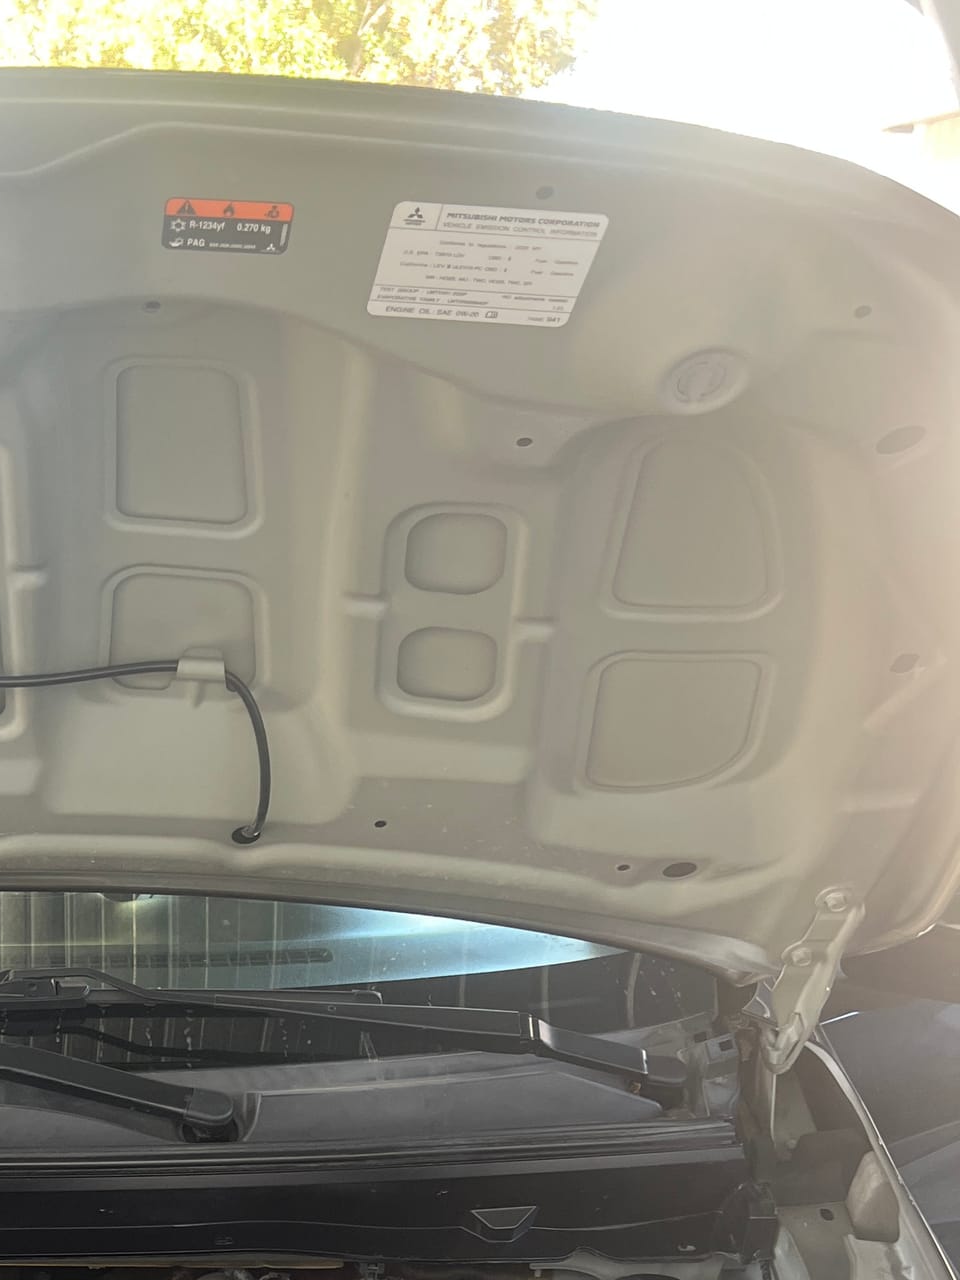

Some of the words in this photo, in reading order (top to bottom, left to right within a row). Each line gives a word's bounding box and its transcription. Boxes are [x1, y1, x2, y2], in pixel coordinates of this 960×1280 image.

[189, 220, 225, 232] R-1234yf
[237, 223, 258, 232] 0.270
[260, 224, 271, 234] kg
[446, 211, 498, 223] MITSUBISHI
[499, 215, 536, 225] MOTORS
[538, 217, 601, 228] CORPORATION
[443, 222, 472, 230] VEHICLE
[476, 224, 510, 233] EMISSION
[513, 226, 546, 235] CONTROL
[549, 228, 598, 238] INFORMATION
[187, 238, 205, 247] PAG
